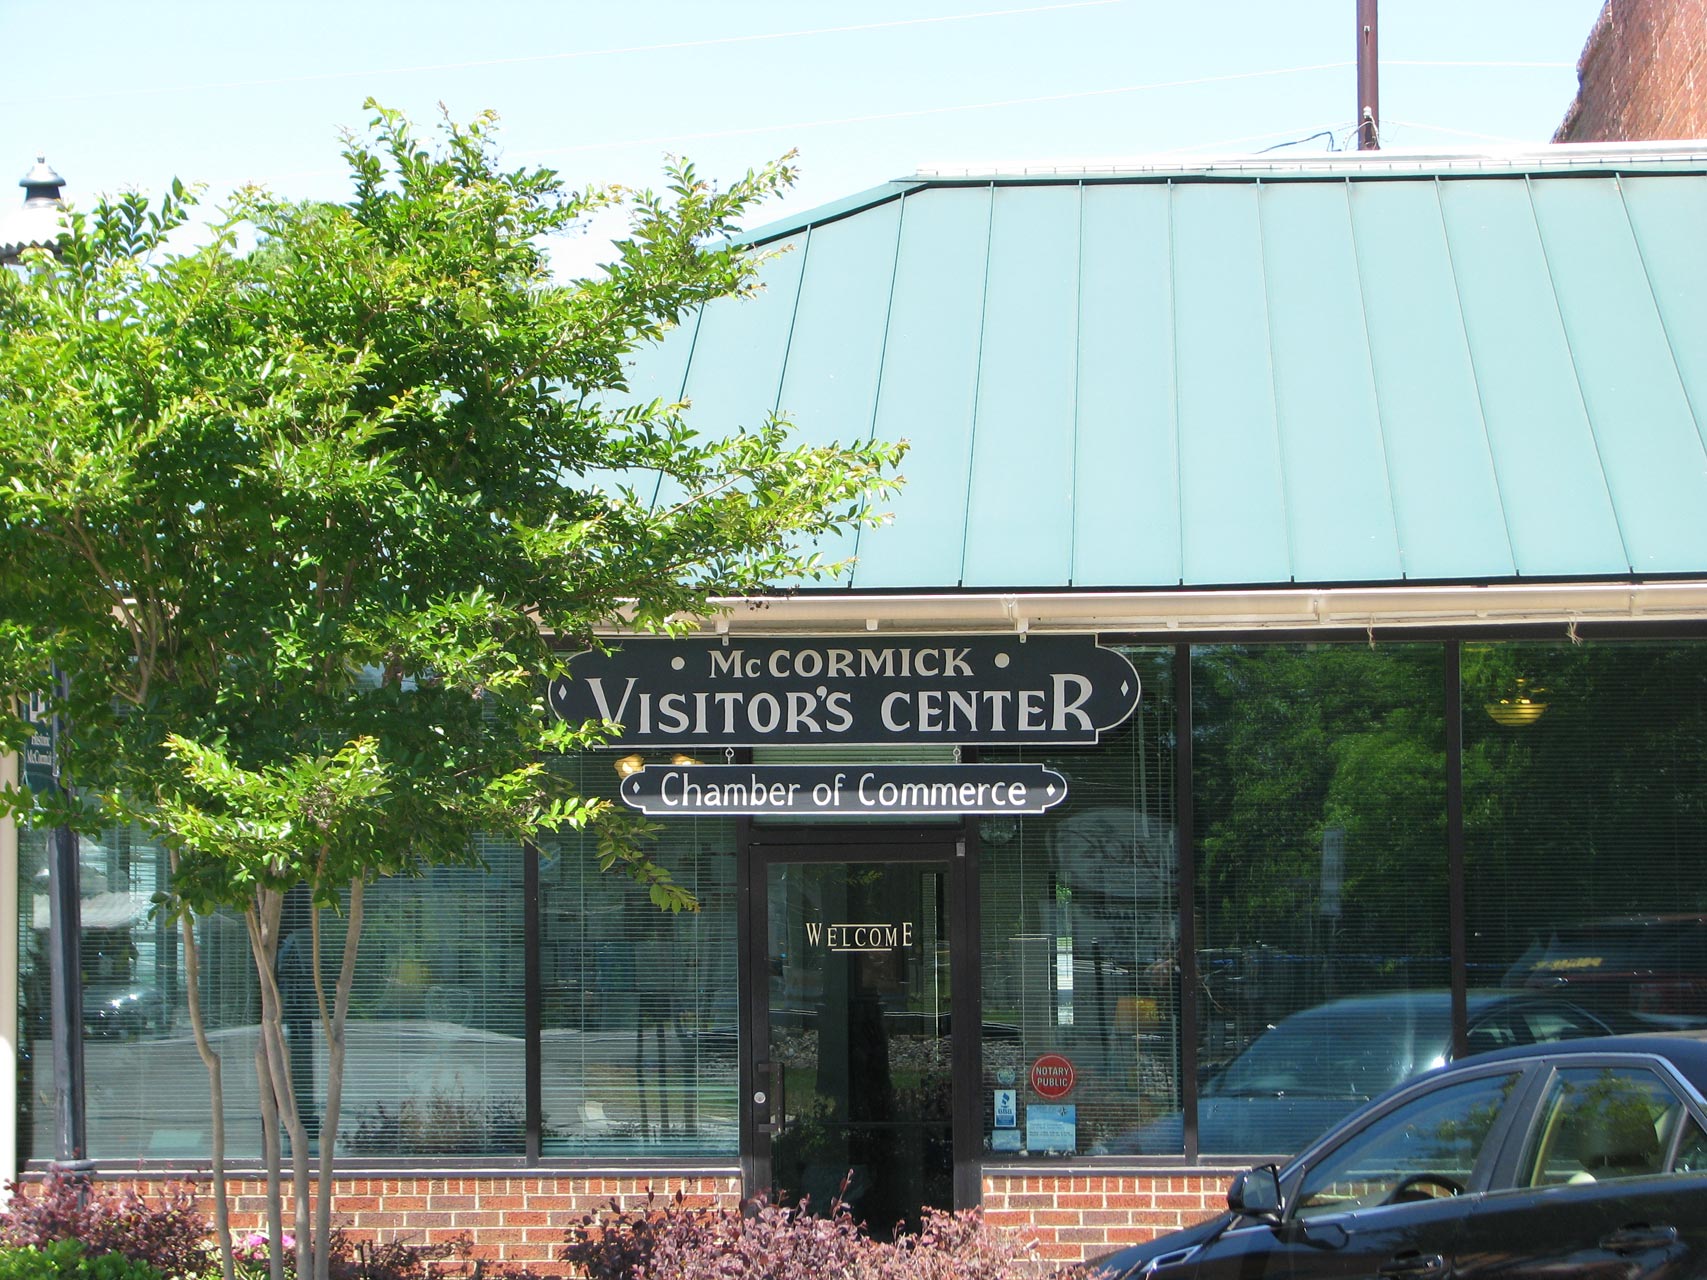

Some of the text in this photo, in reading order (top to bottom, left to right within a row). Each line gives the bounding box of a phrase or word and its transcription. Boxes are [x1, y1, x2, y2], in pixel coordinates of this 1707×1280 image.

[584, 673, 1097, 734] VISITOR'S CENTER
[661, 772, 1027, 806] Chamber of Commerce
[805, 922, 913, 947] WELCOME
[1035, 1066, 1070, 1076] NOTARY
[1037, 1078, 1068, 1087] PUBLIC
